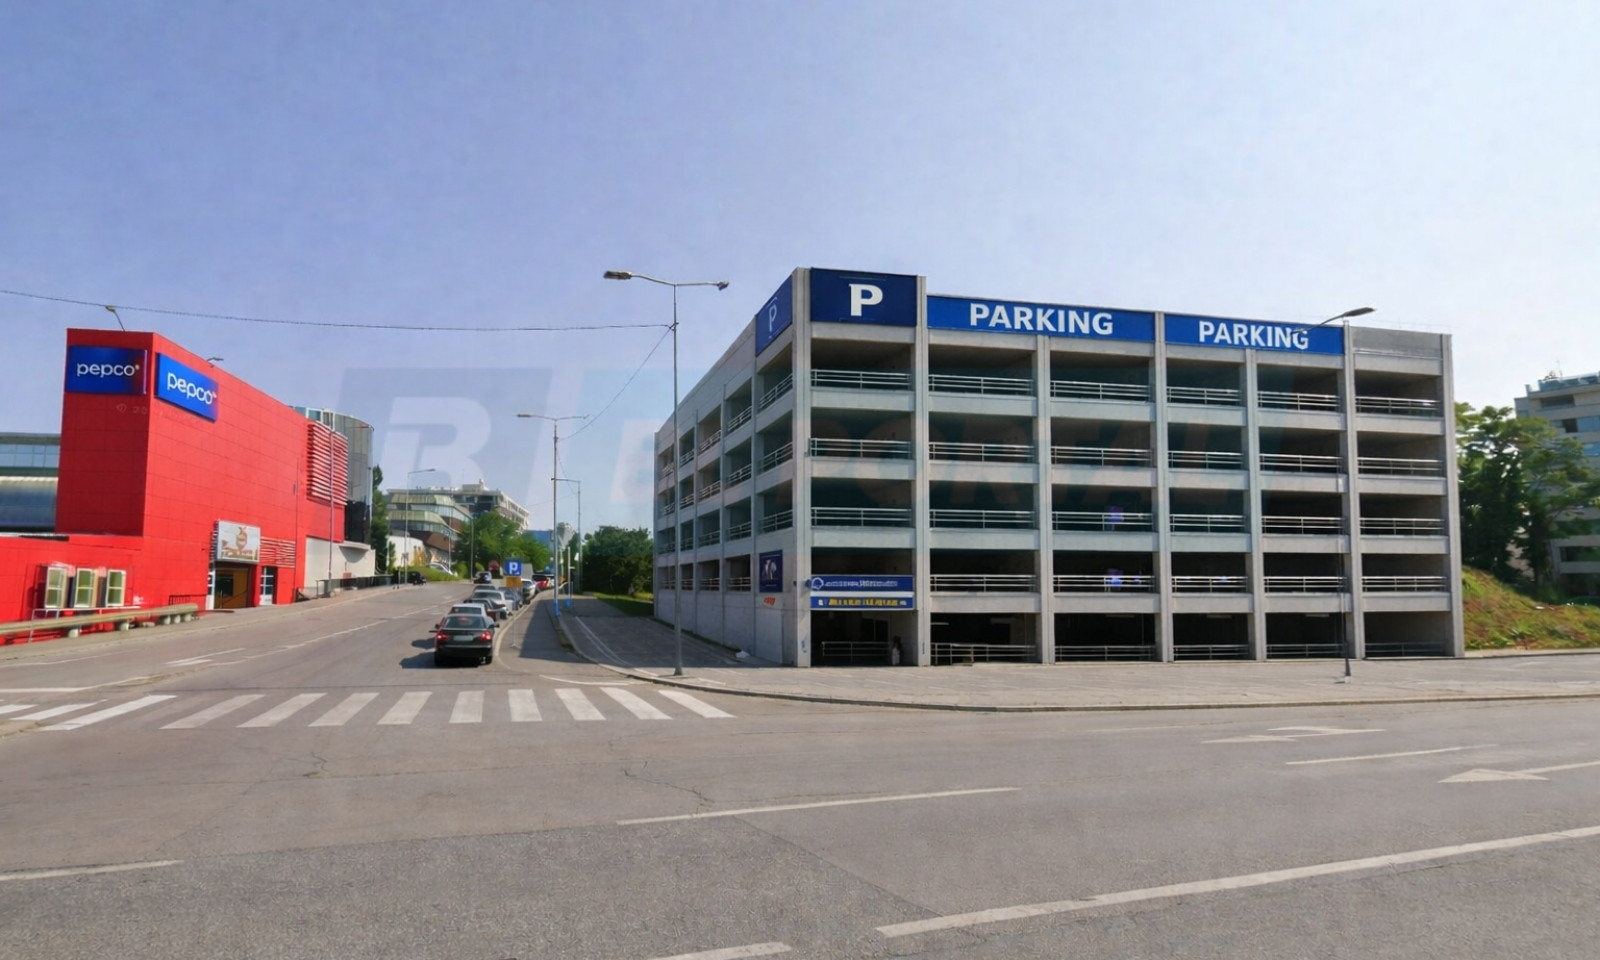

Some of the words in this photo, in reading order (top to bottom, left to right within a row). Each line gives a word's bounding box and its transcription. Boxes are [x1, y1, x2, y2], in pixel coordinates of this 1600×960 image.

[849, 283, 883, 317] P
[970, 302, 1113, 335] PARKING
[1199, 320, 1308, 350] PARKING
[76, 363, 136, 378] pepco
[166, 372, 213, 405] pepco
[508, 561, 519, 575] P
